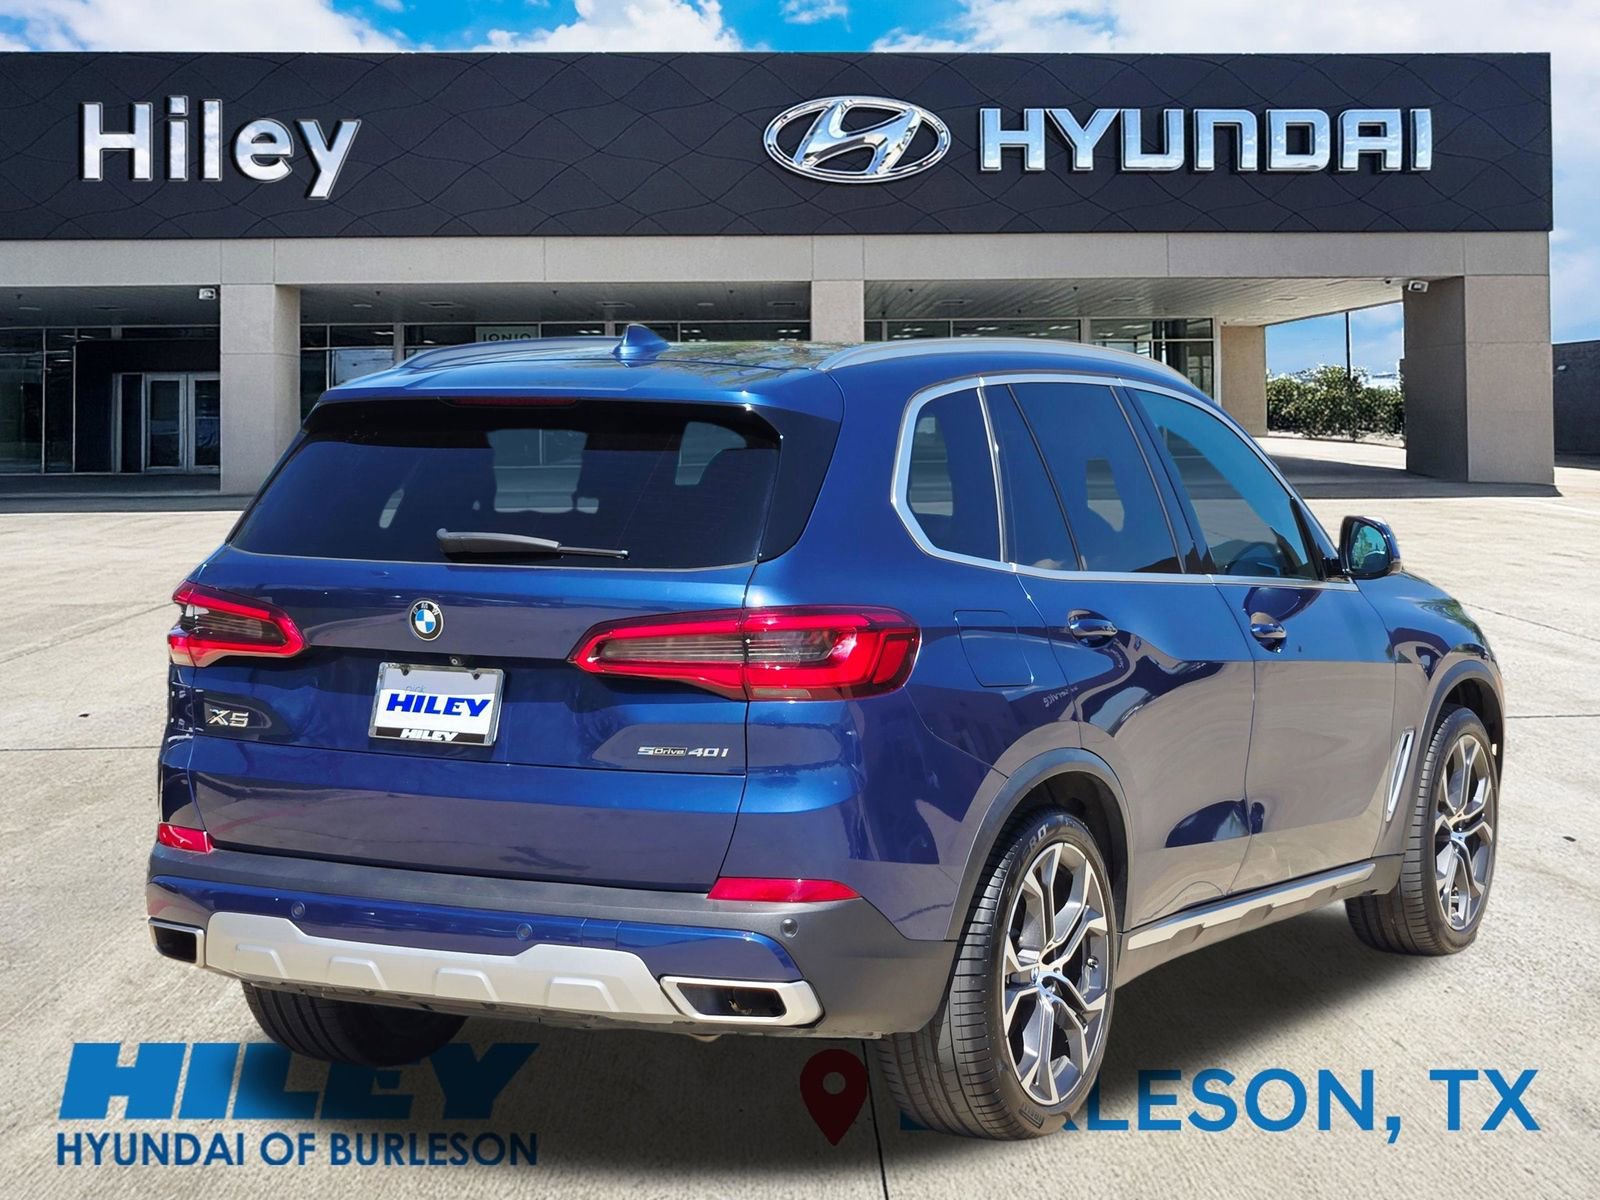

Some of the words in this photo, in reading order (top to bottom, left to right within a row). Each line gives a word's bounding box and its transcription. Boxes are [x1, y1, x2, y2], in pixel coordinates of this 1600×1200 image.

[80, 95, 361, 199] Hiley
[980, 108, 1432, 172] HYUNDAI
[209, 708, 249, 727] X5
[386, 693, 492, 718] HILEY
[400, 728, 459, 742] HILEY
